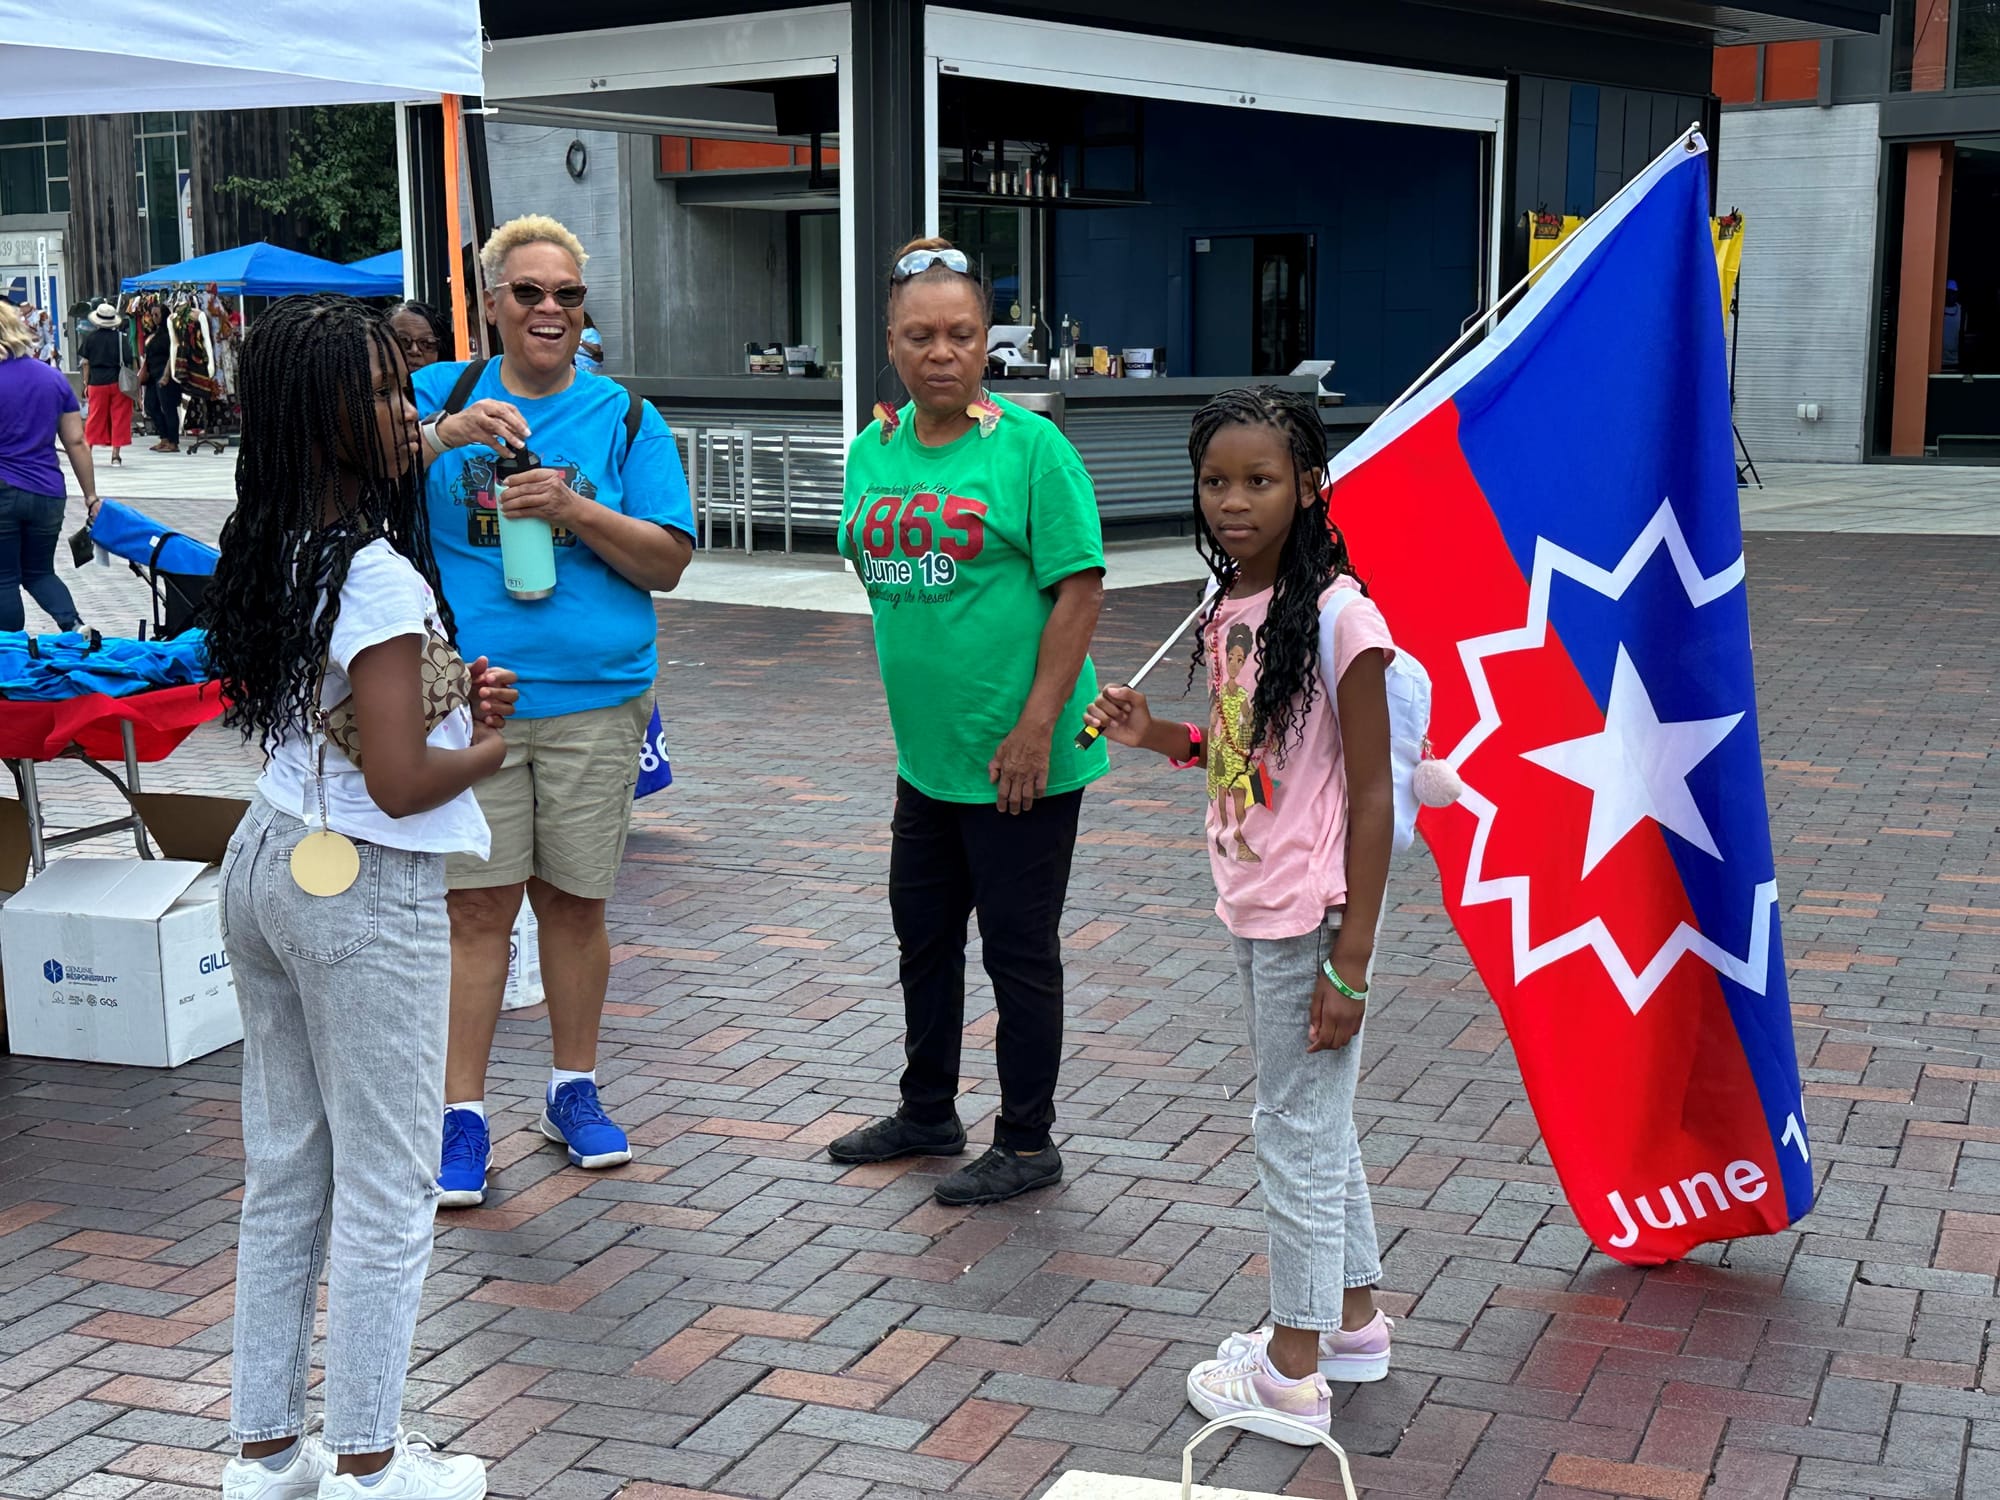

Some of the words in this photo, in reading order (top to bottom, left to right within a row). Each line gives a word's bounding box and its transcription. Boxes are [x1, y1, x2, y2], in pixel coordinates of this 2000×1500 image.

[863, 550, 912, 584] June
[919, 551, 956, 587] 19
[1606, 1159, 1768, 1249] June
[1781, 1092, 1810, 1164] 1
